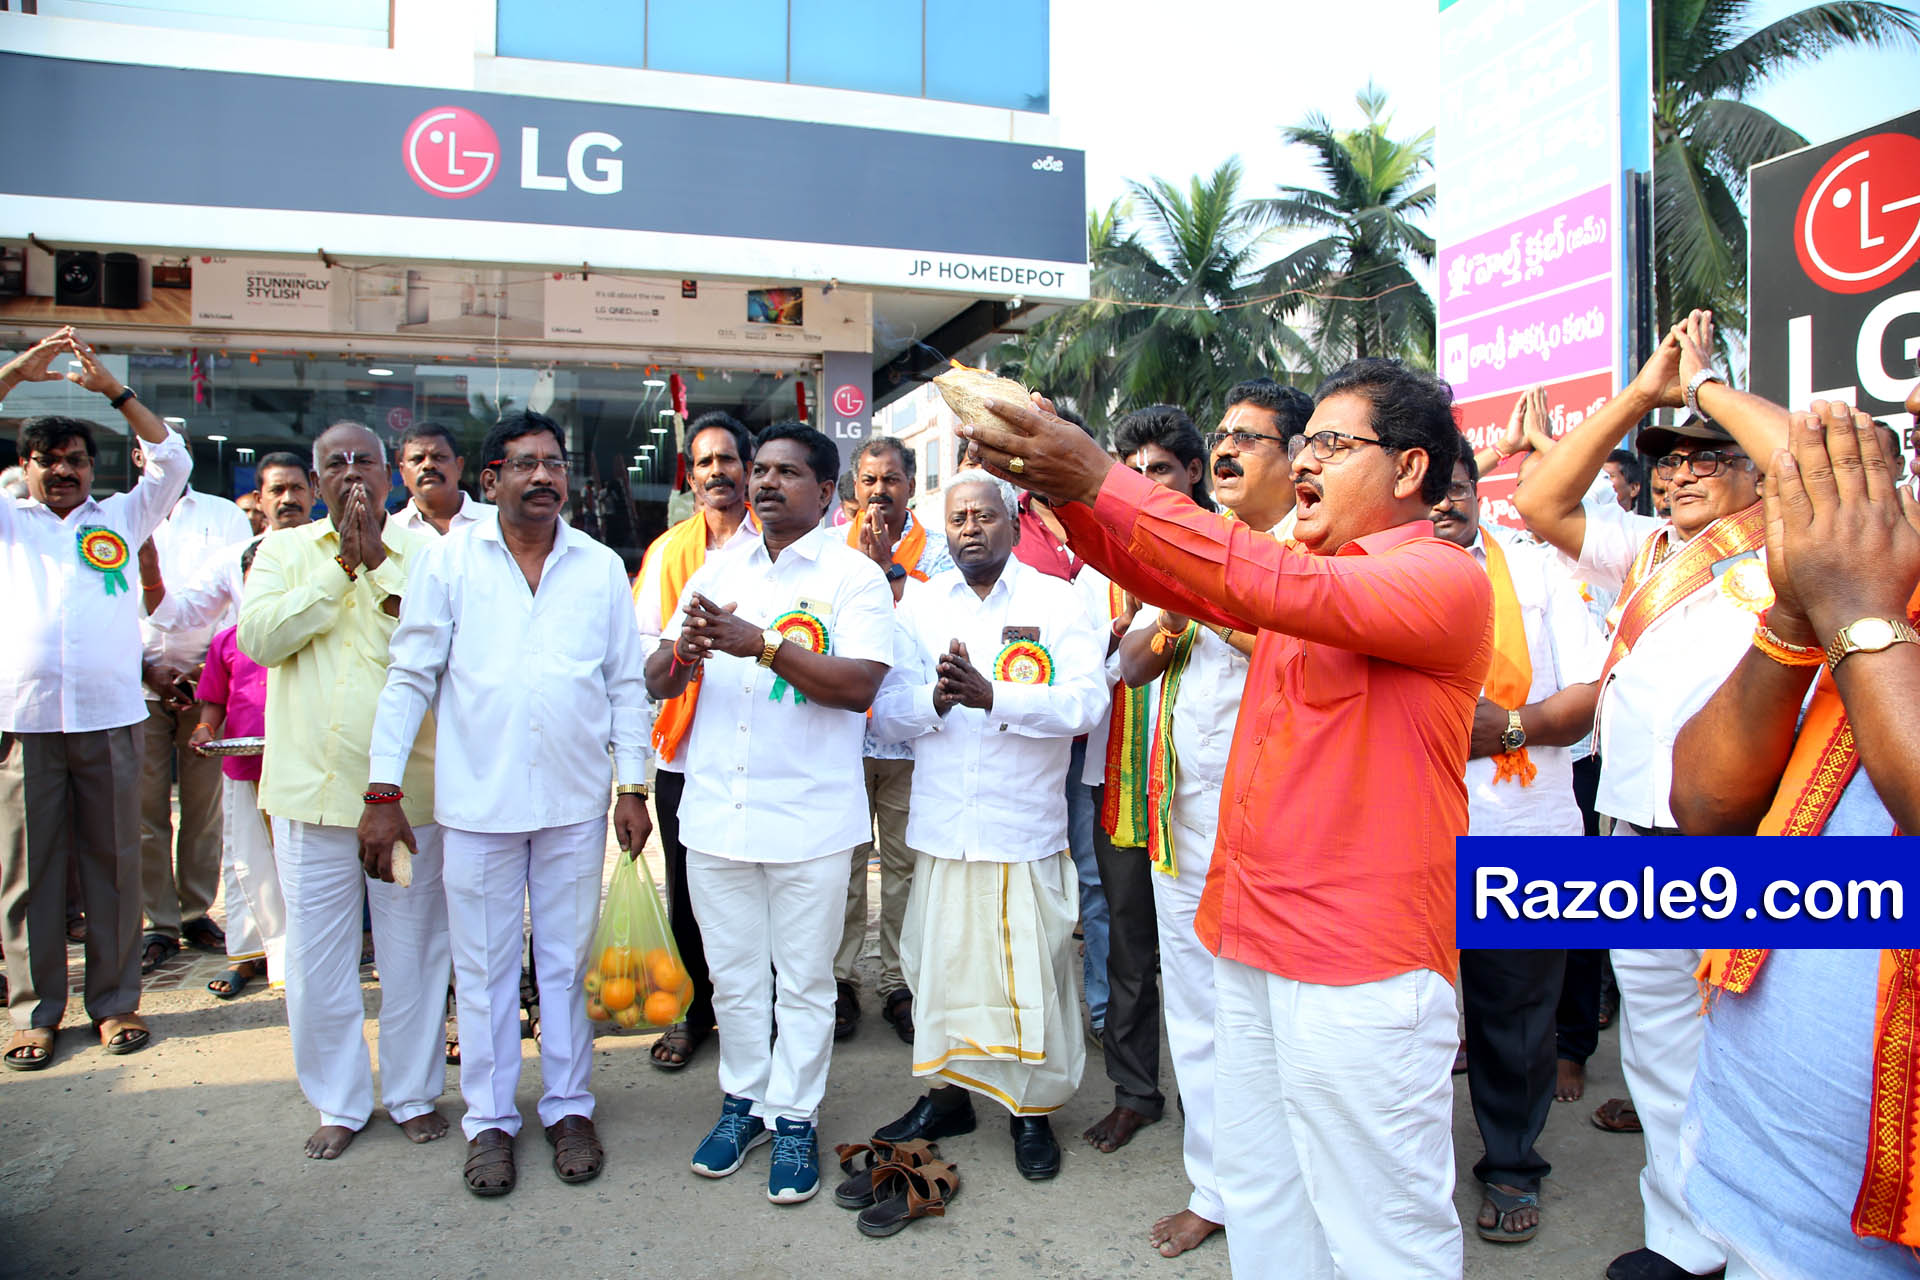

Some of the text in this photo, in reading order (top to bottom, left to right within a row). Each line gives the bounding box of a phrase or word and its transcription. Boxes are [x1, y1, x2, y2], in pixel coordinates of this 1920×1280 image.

[520, 126, 623, 195] LG
[908, 260, 1065, 288] JP HOMEDEPOT
[247, 276, 330, 291] STUNNINGLY
[247, 287, 300, 299] STYLISH
[595, 306, 606, 314] LG
[835, 421, 862, 439] LG
[1466, 426, 1484, 449] 24
